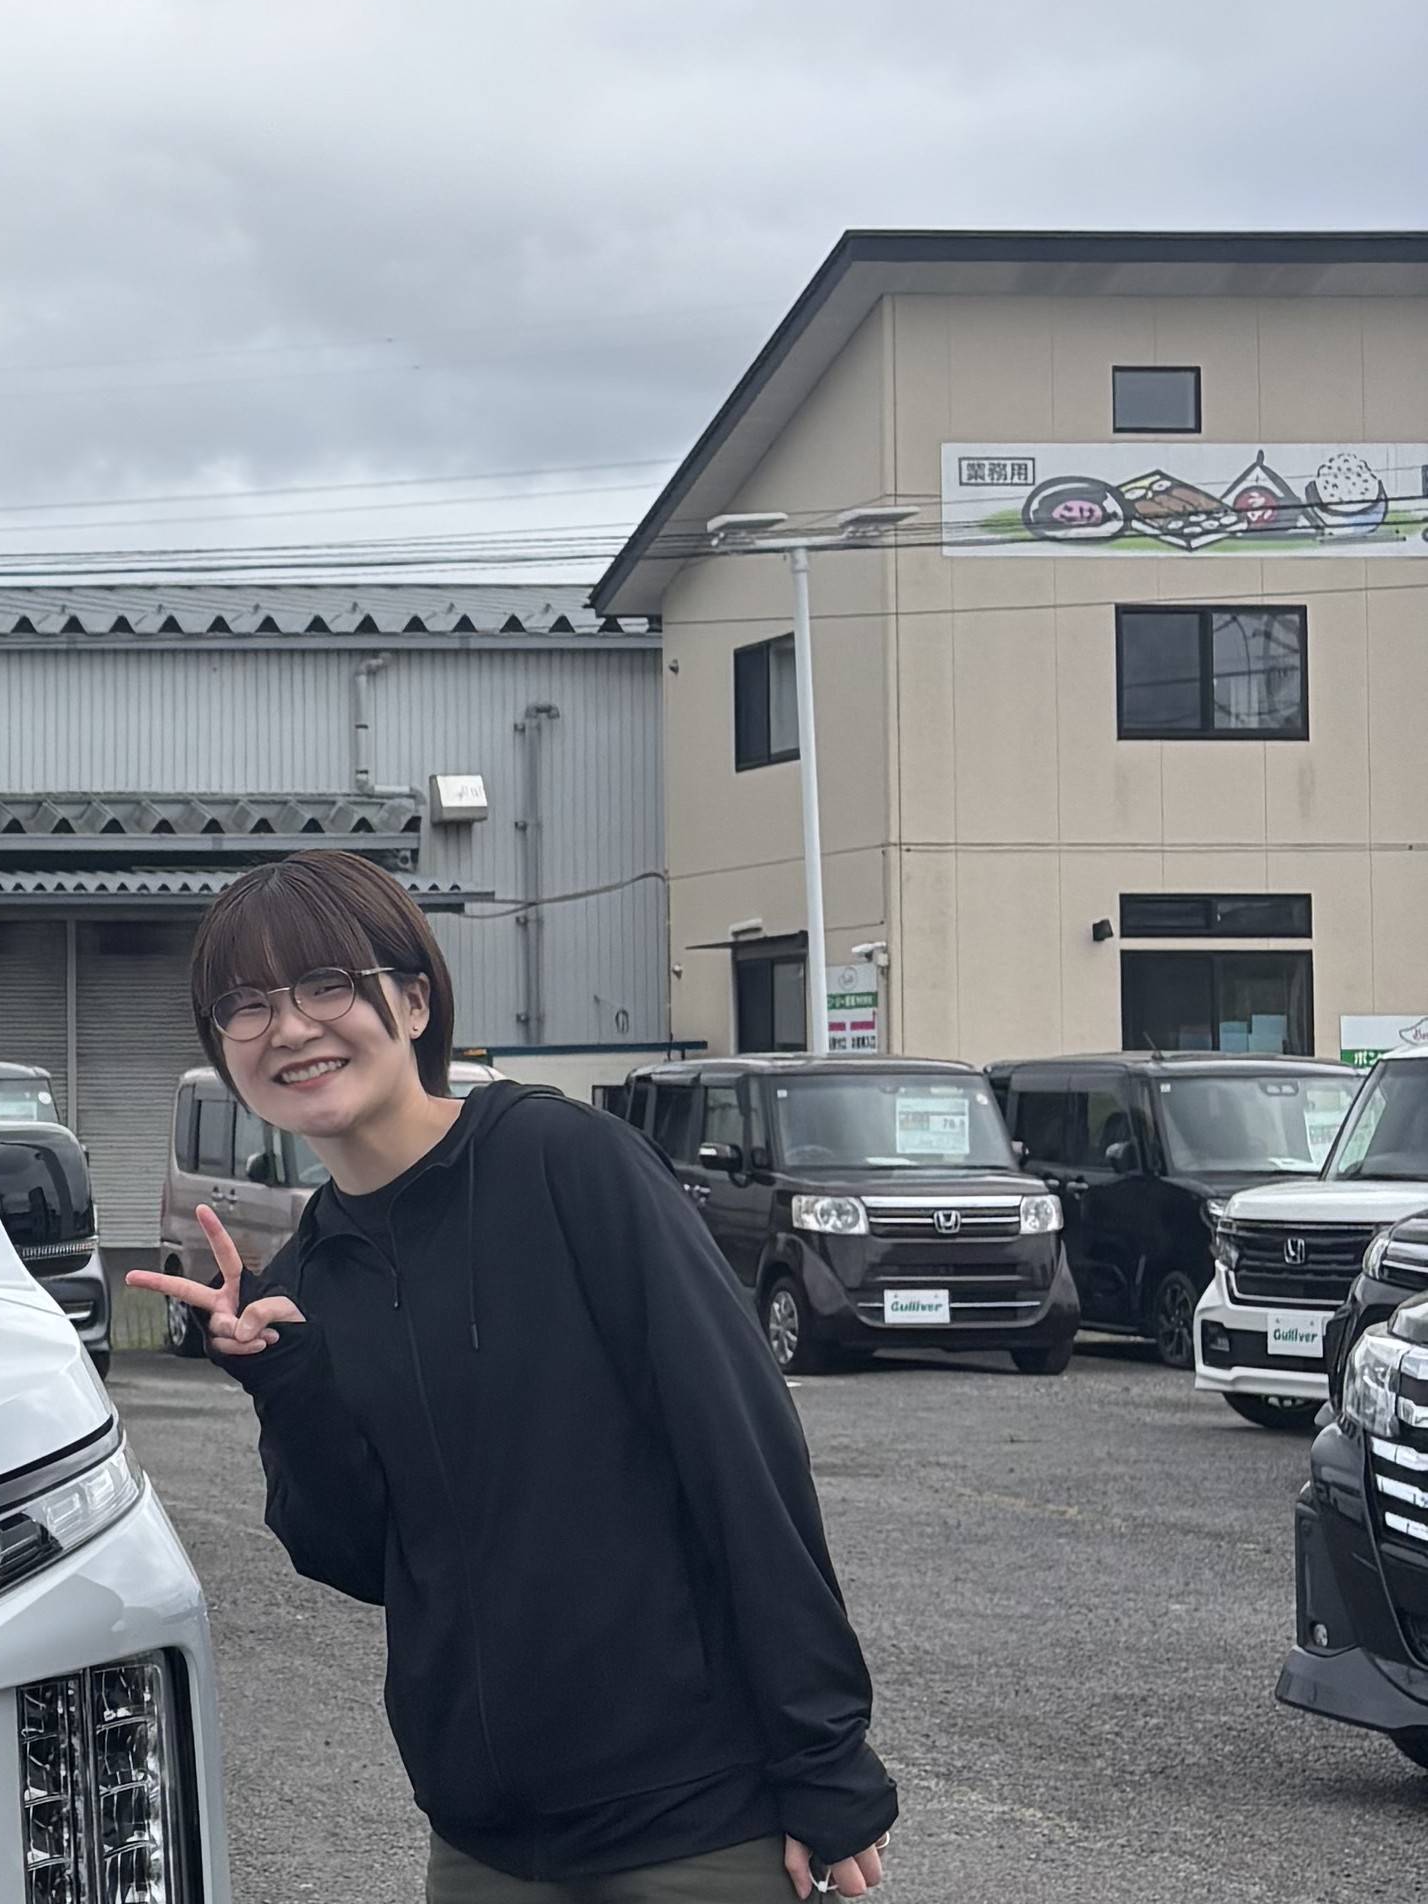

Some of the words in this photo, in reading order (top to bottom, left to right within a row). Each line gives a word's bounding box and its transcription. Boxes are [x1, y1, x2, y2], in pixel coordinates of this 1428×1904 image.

[966, 462, 1028, 481] 業務用
[890, 1300, 943, 1312] Gulliver
[1273, 1328, 1318, 1343] Gulliver
